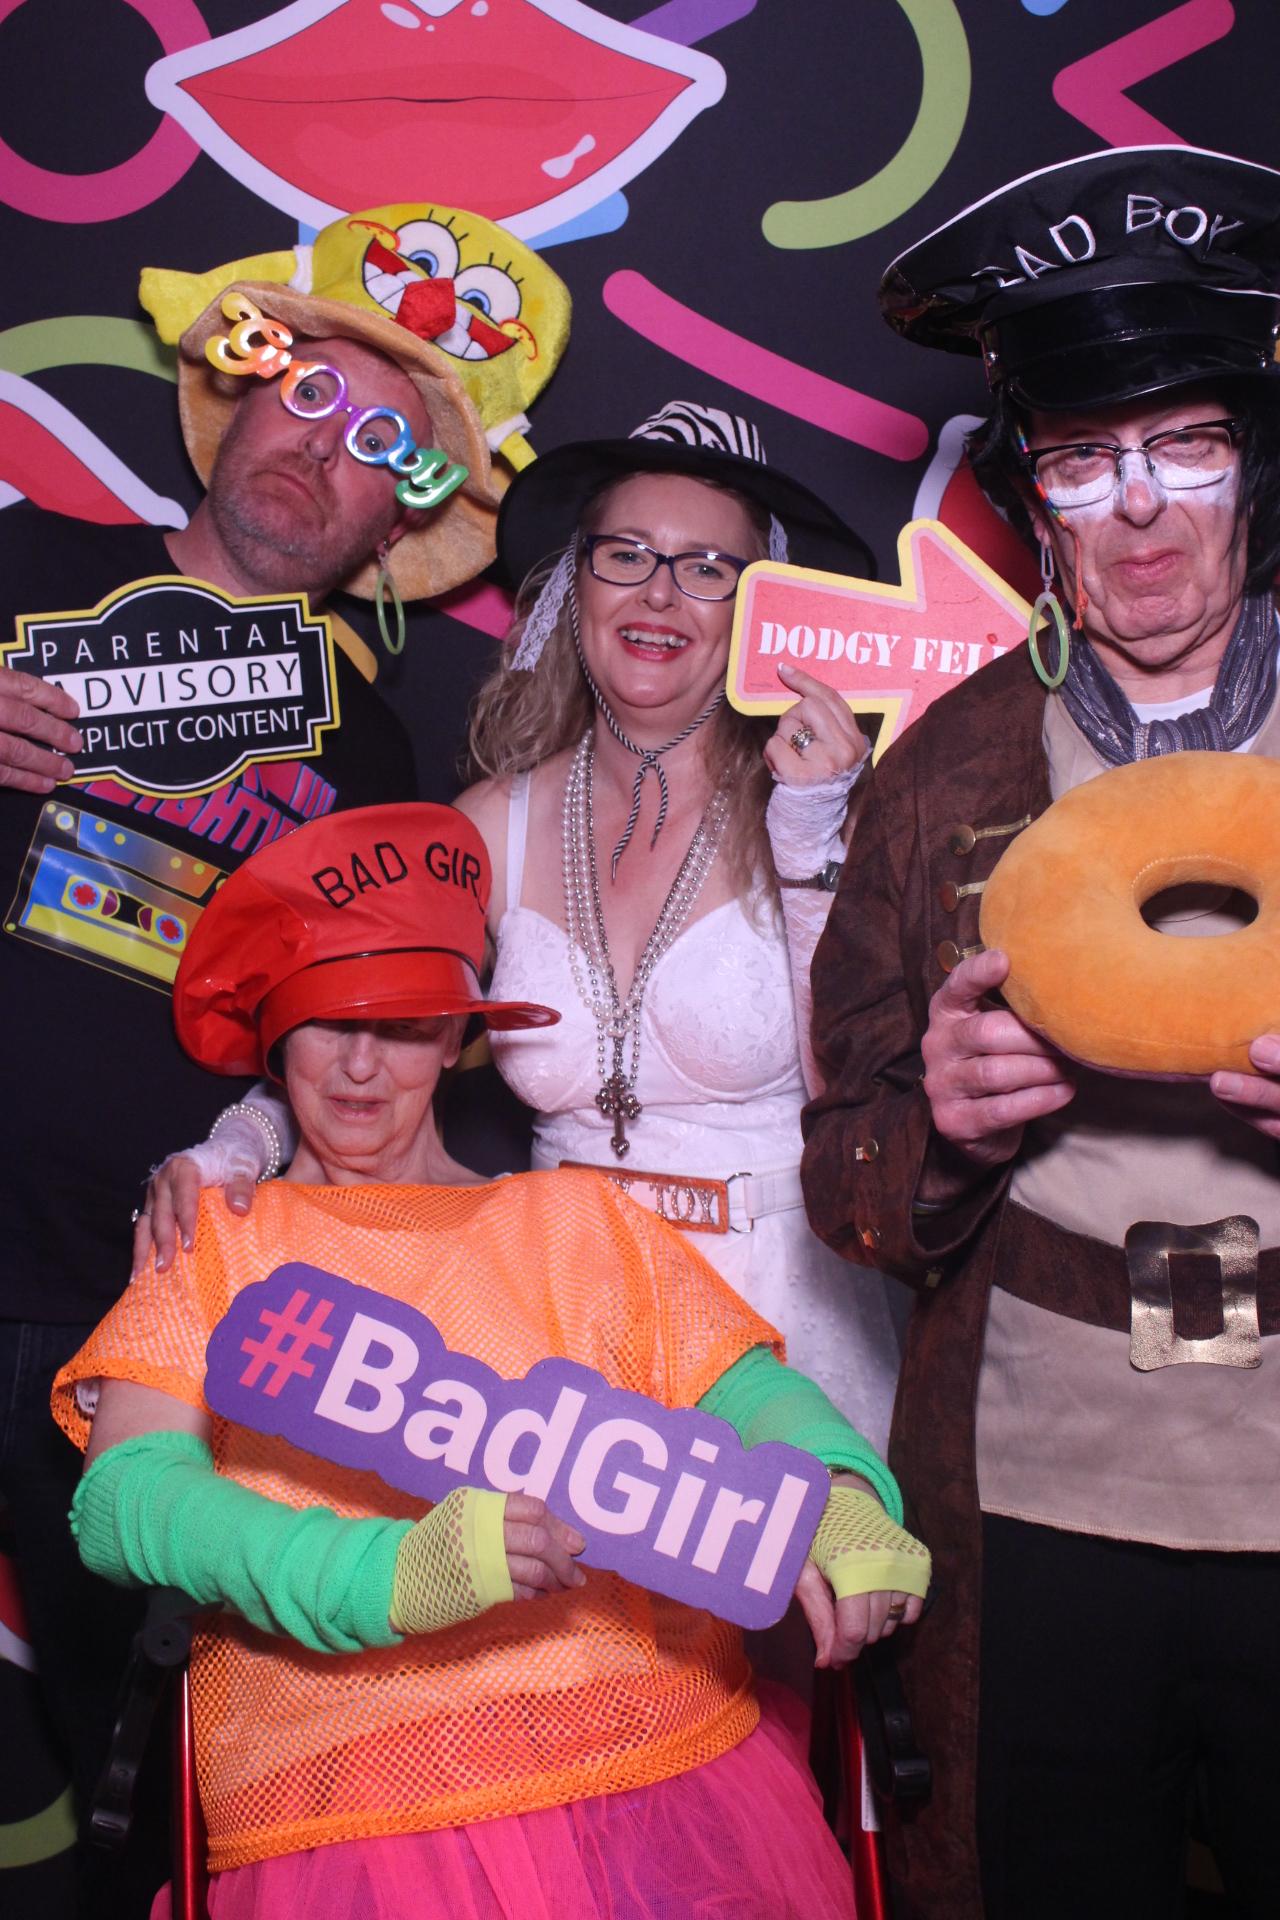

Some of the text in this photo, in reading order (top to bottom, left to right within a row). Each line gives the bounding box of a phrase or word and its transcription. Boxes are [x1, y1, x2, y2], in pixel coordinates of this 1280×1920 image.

[1126, 194, 1245, 255] BOY
[41, 621, 297, 667] PARENTAL
[757, 621, 901, 668] DODGY
[51, 657, 299, 712] DVISORY
[53, 705, 304, 757] PLICIT CONTENT
[311, 841, 485, 915] BAD GIR
[238, 1289, 809, 1597] #BadGirl
